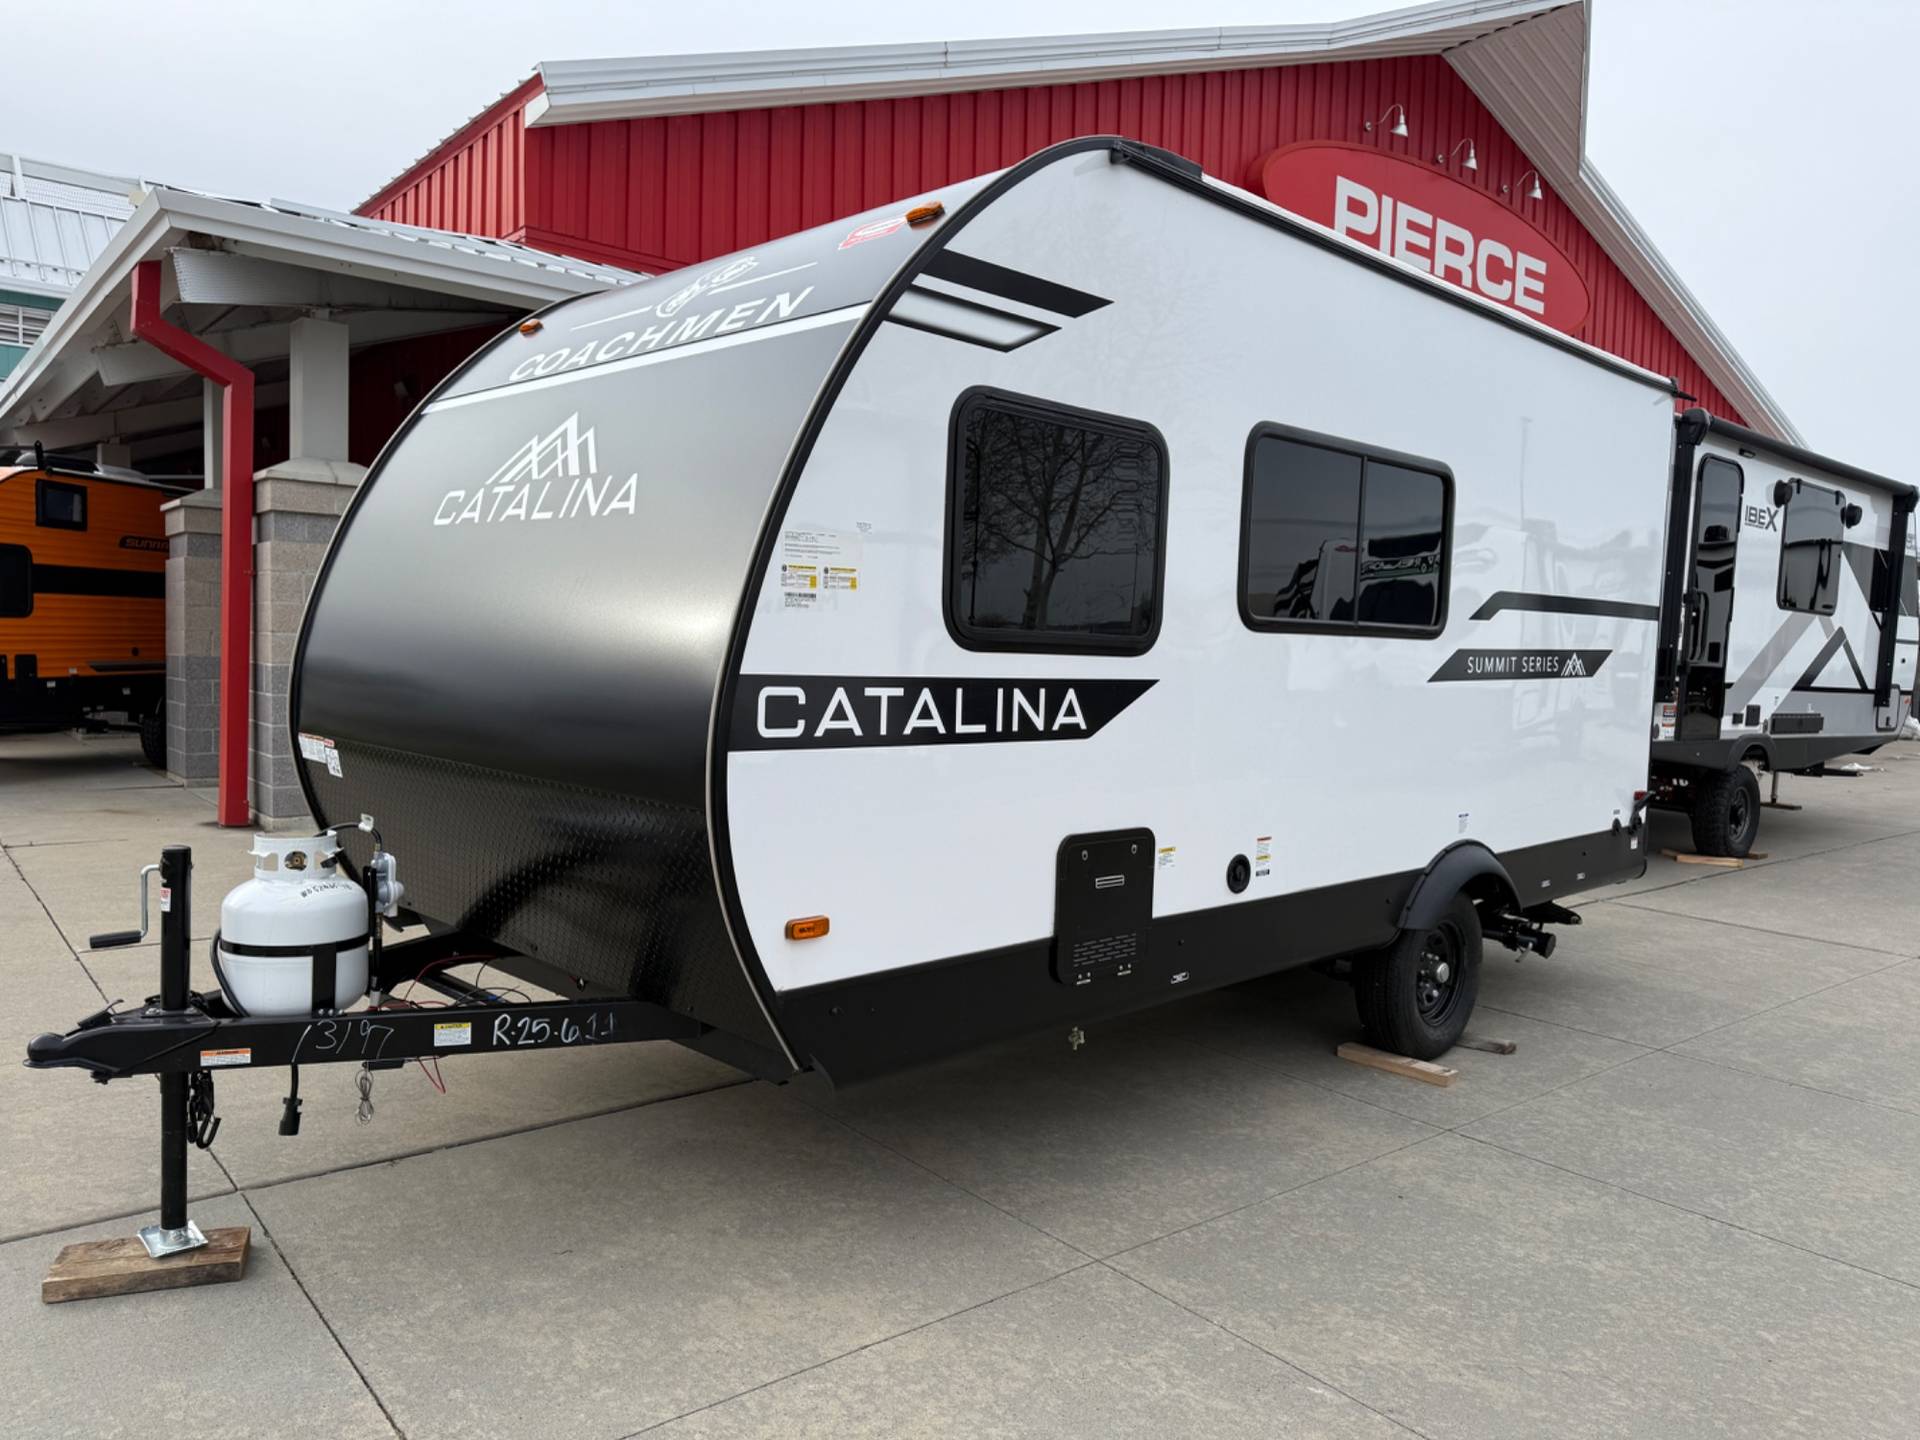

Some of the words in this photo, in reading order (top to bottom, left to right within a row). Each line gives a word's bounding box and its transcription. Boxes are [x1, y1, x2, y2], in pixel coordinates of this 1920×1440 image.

[1334, 175, 1548, 315] PIERCE
[508, 286, 815, 381] COACHMEN
[433, 473, 638, 526] CATALINA
[1744, 504, 1779, 532] IBEX
[1466, 656, 1518, 674] SUMMIT
[1521, 656, 1560, 673] SERIES
[756, 686, 1088, 739] CATALINA
